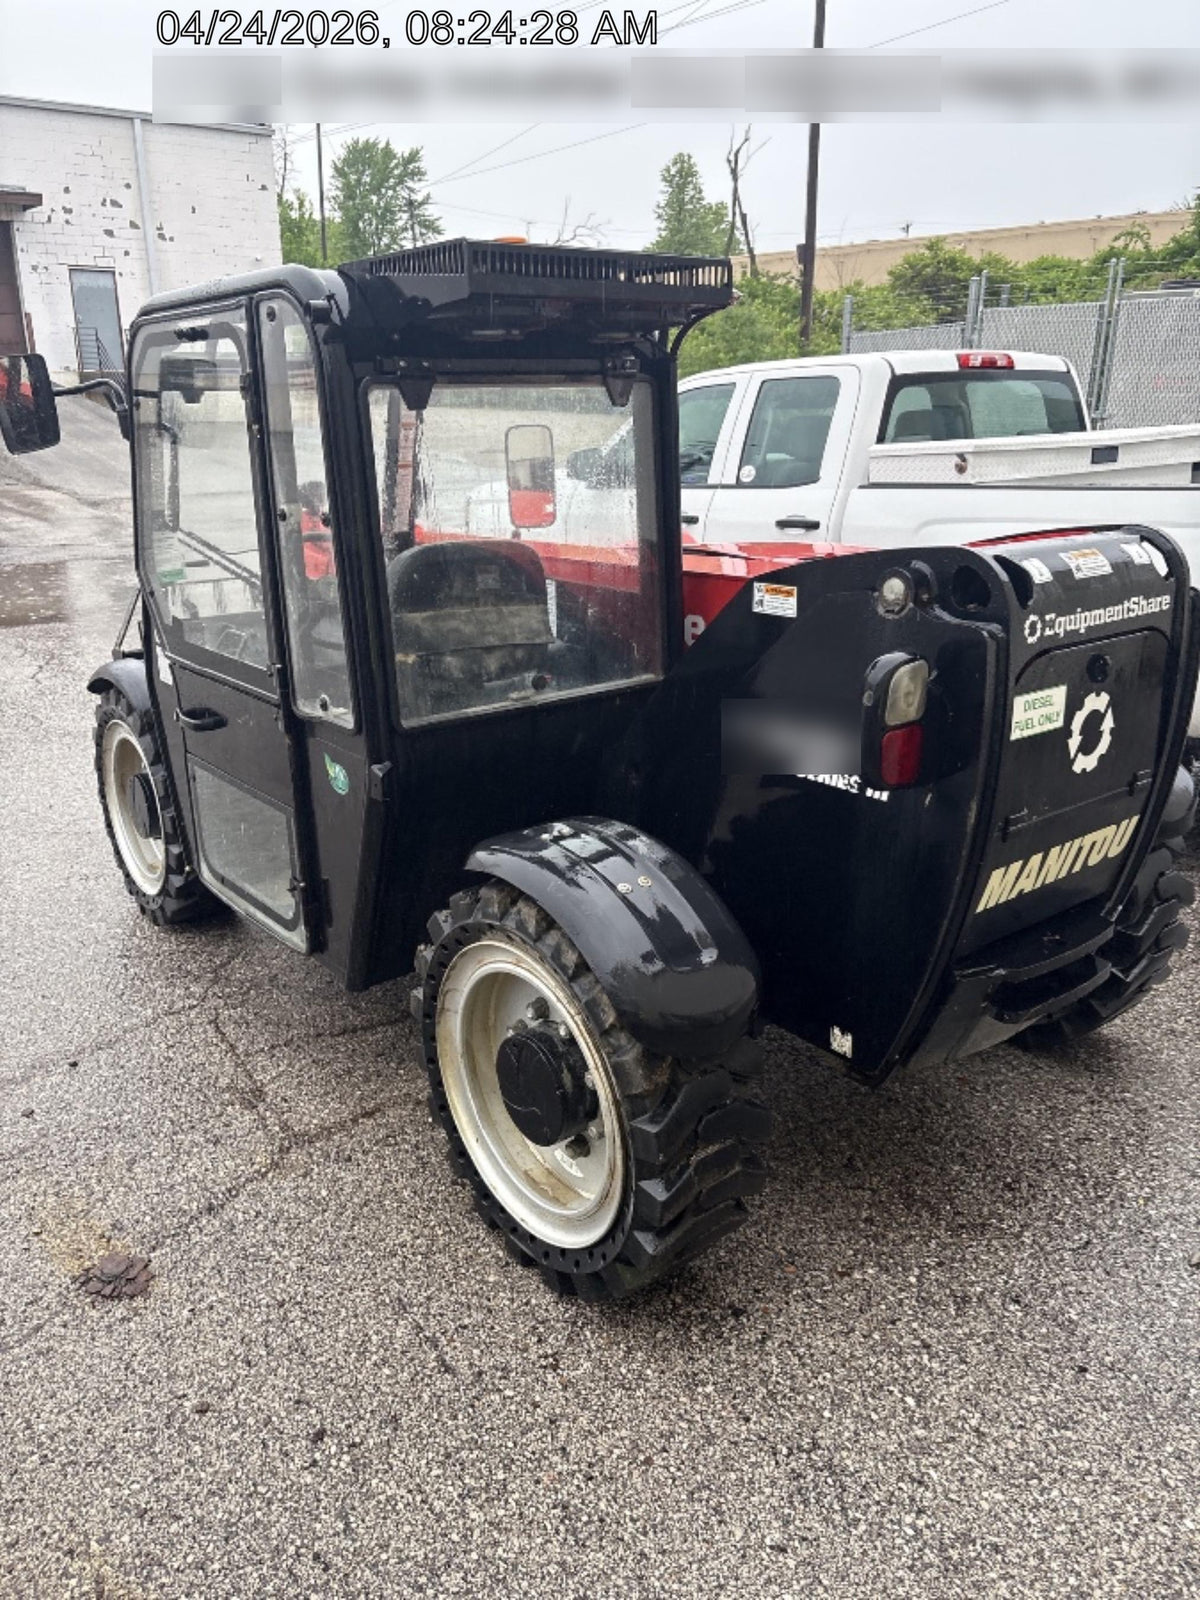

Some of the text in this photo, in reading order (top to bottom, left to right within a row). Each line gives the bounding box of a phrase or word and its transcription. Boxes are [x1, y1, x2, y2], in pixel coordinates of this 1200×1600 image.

[1044, 594, 1171, 638] EquipmentShare
[1023, 694, 1054, 713] DIESEL
[1013, 710, 1061, 733] FUEL ONLY
[975, 814, 1141, 914] MANITOU
